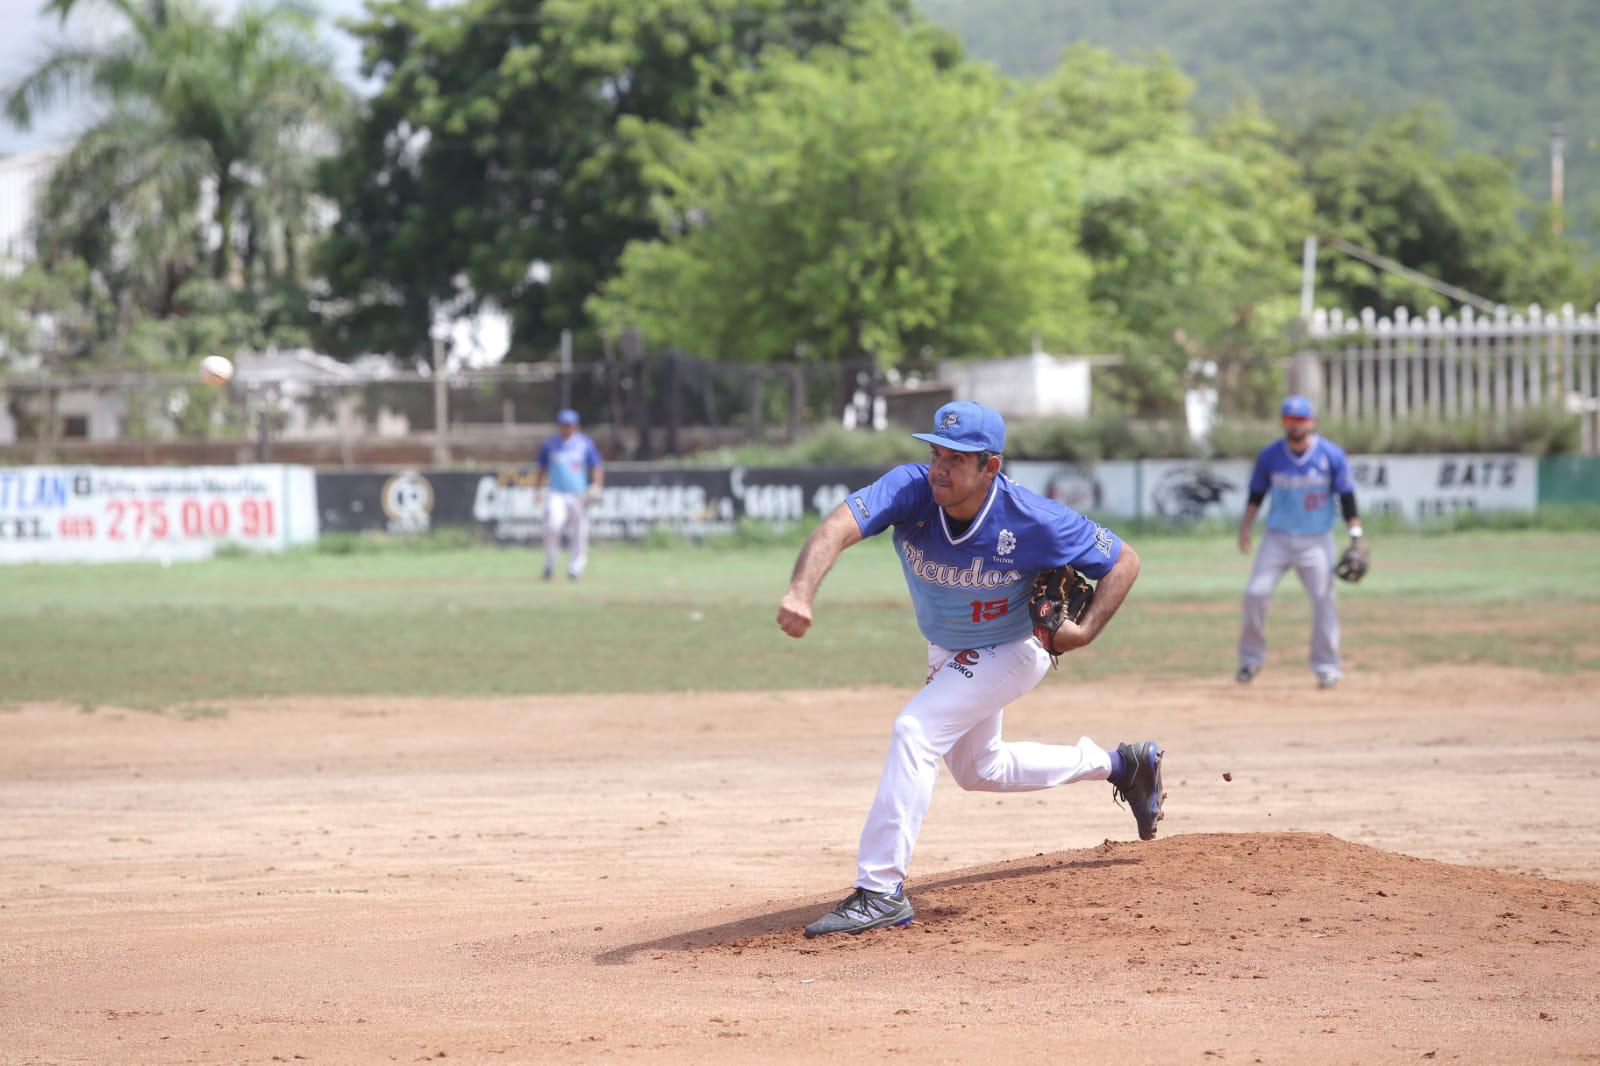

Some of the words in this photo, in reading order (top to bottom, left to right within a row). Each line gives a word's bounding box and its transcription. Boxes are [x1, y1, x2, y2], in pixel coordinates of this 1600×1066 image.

[106, 498, 170, 540] 275
[181, 498, 230, 538] 00
[239, 498, 275, 538] 91
[903, 540, 1022, 590] Picudos
[970, 598, 1009, 624] 15
